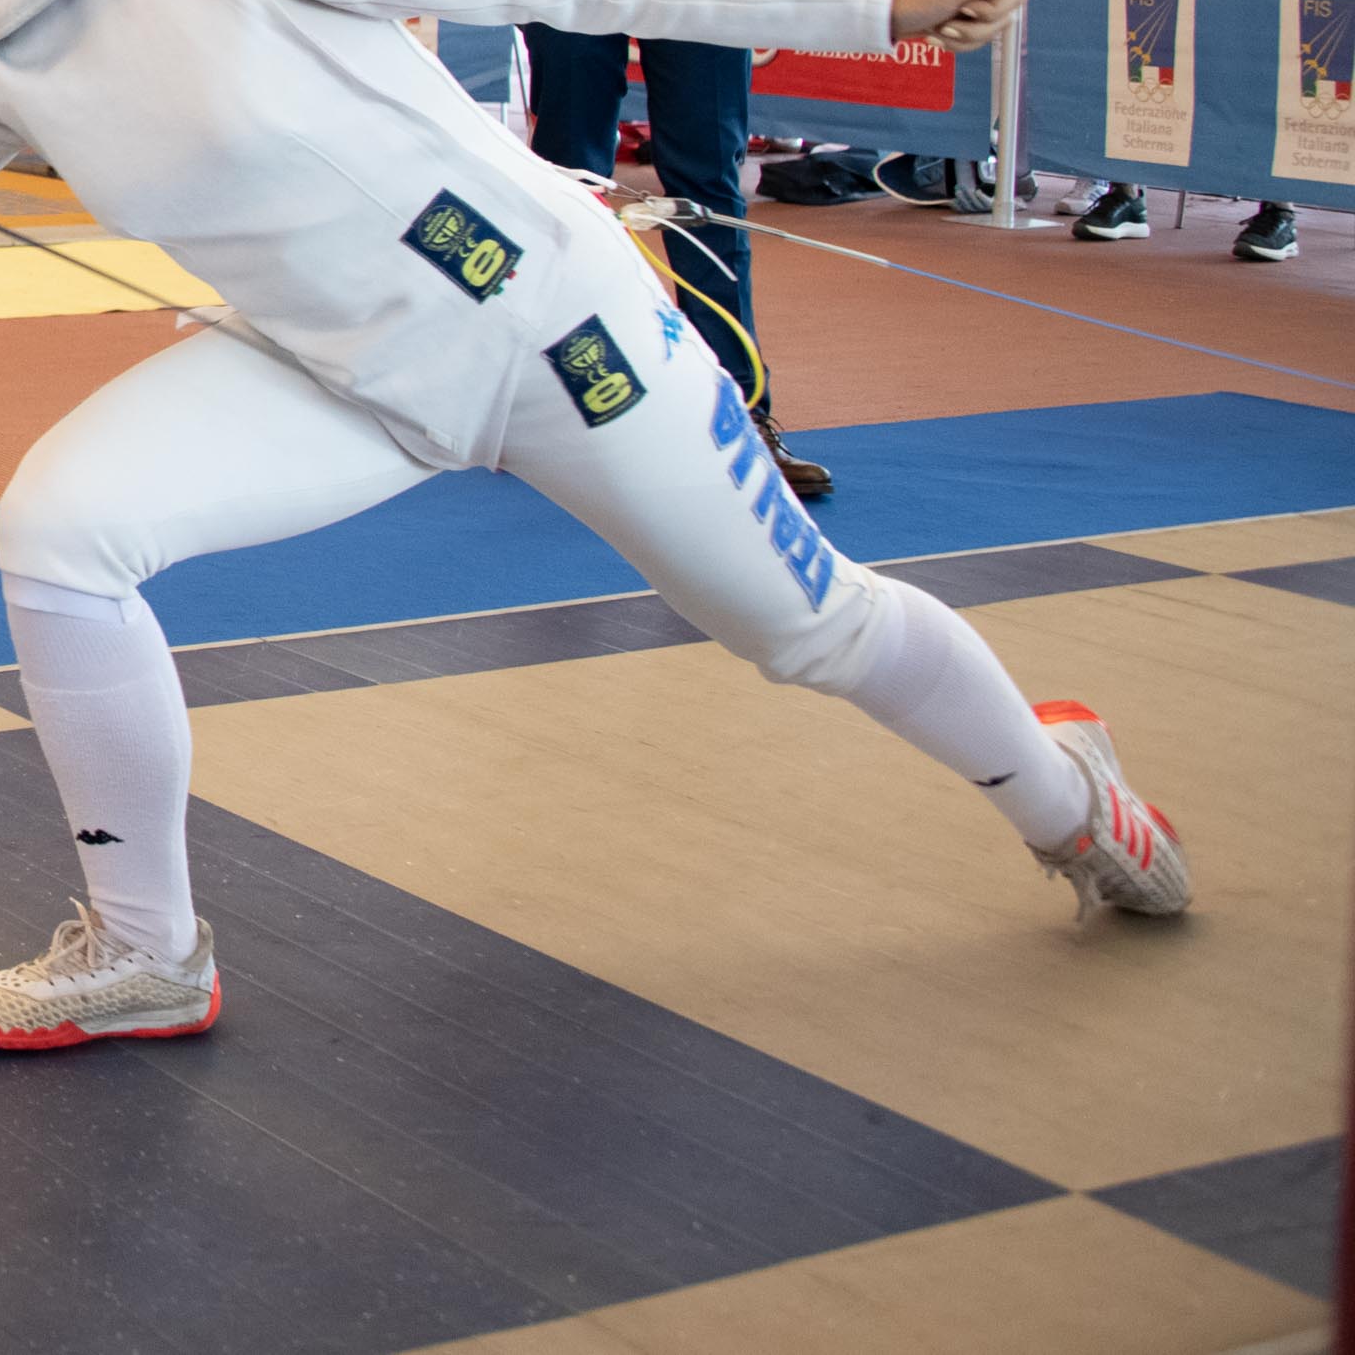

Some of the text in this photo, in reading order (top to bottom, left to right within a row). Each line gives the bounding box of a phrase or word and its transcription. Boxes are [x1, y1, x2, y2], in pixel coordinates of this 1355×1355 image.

[1303, 0, 1332, 17] FIS
[1114, 101, 1187, 121] Federazione
[1127, 119, 1172, 135] Italiana
[1284, 117, 1355, 136] Federazion
[1122, 134, 1174, 152] Scherma
[1298, 135, 1349, 153] Italiana
[1292, 152, 1351, 172] Scherma
[711, 374, 833, 613] ITALIA
